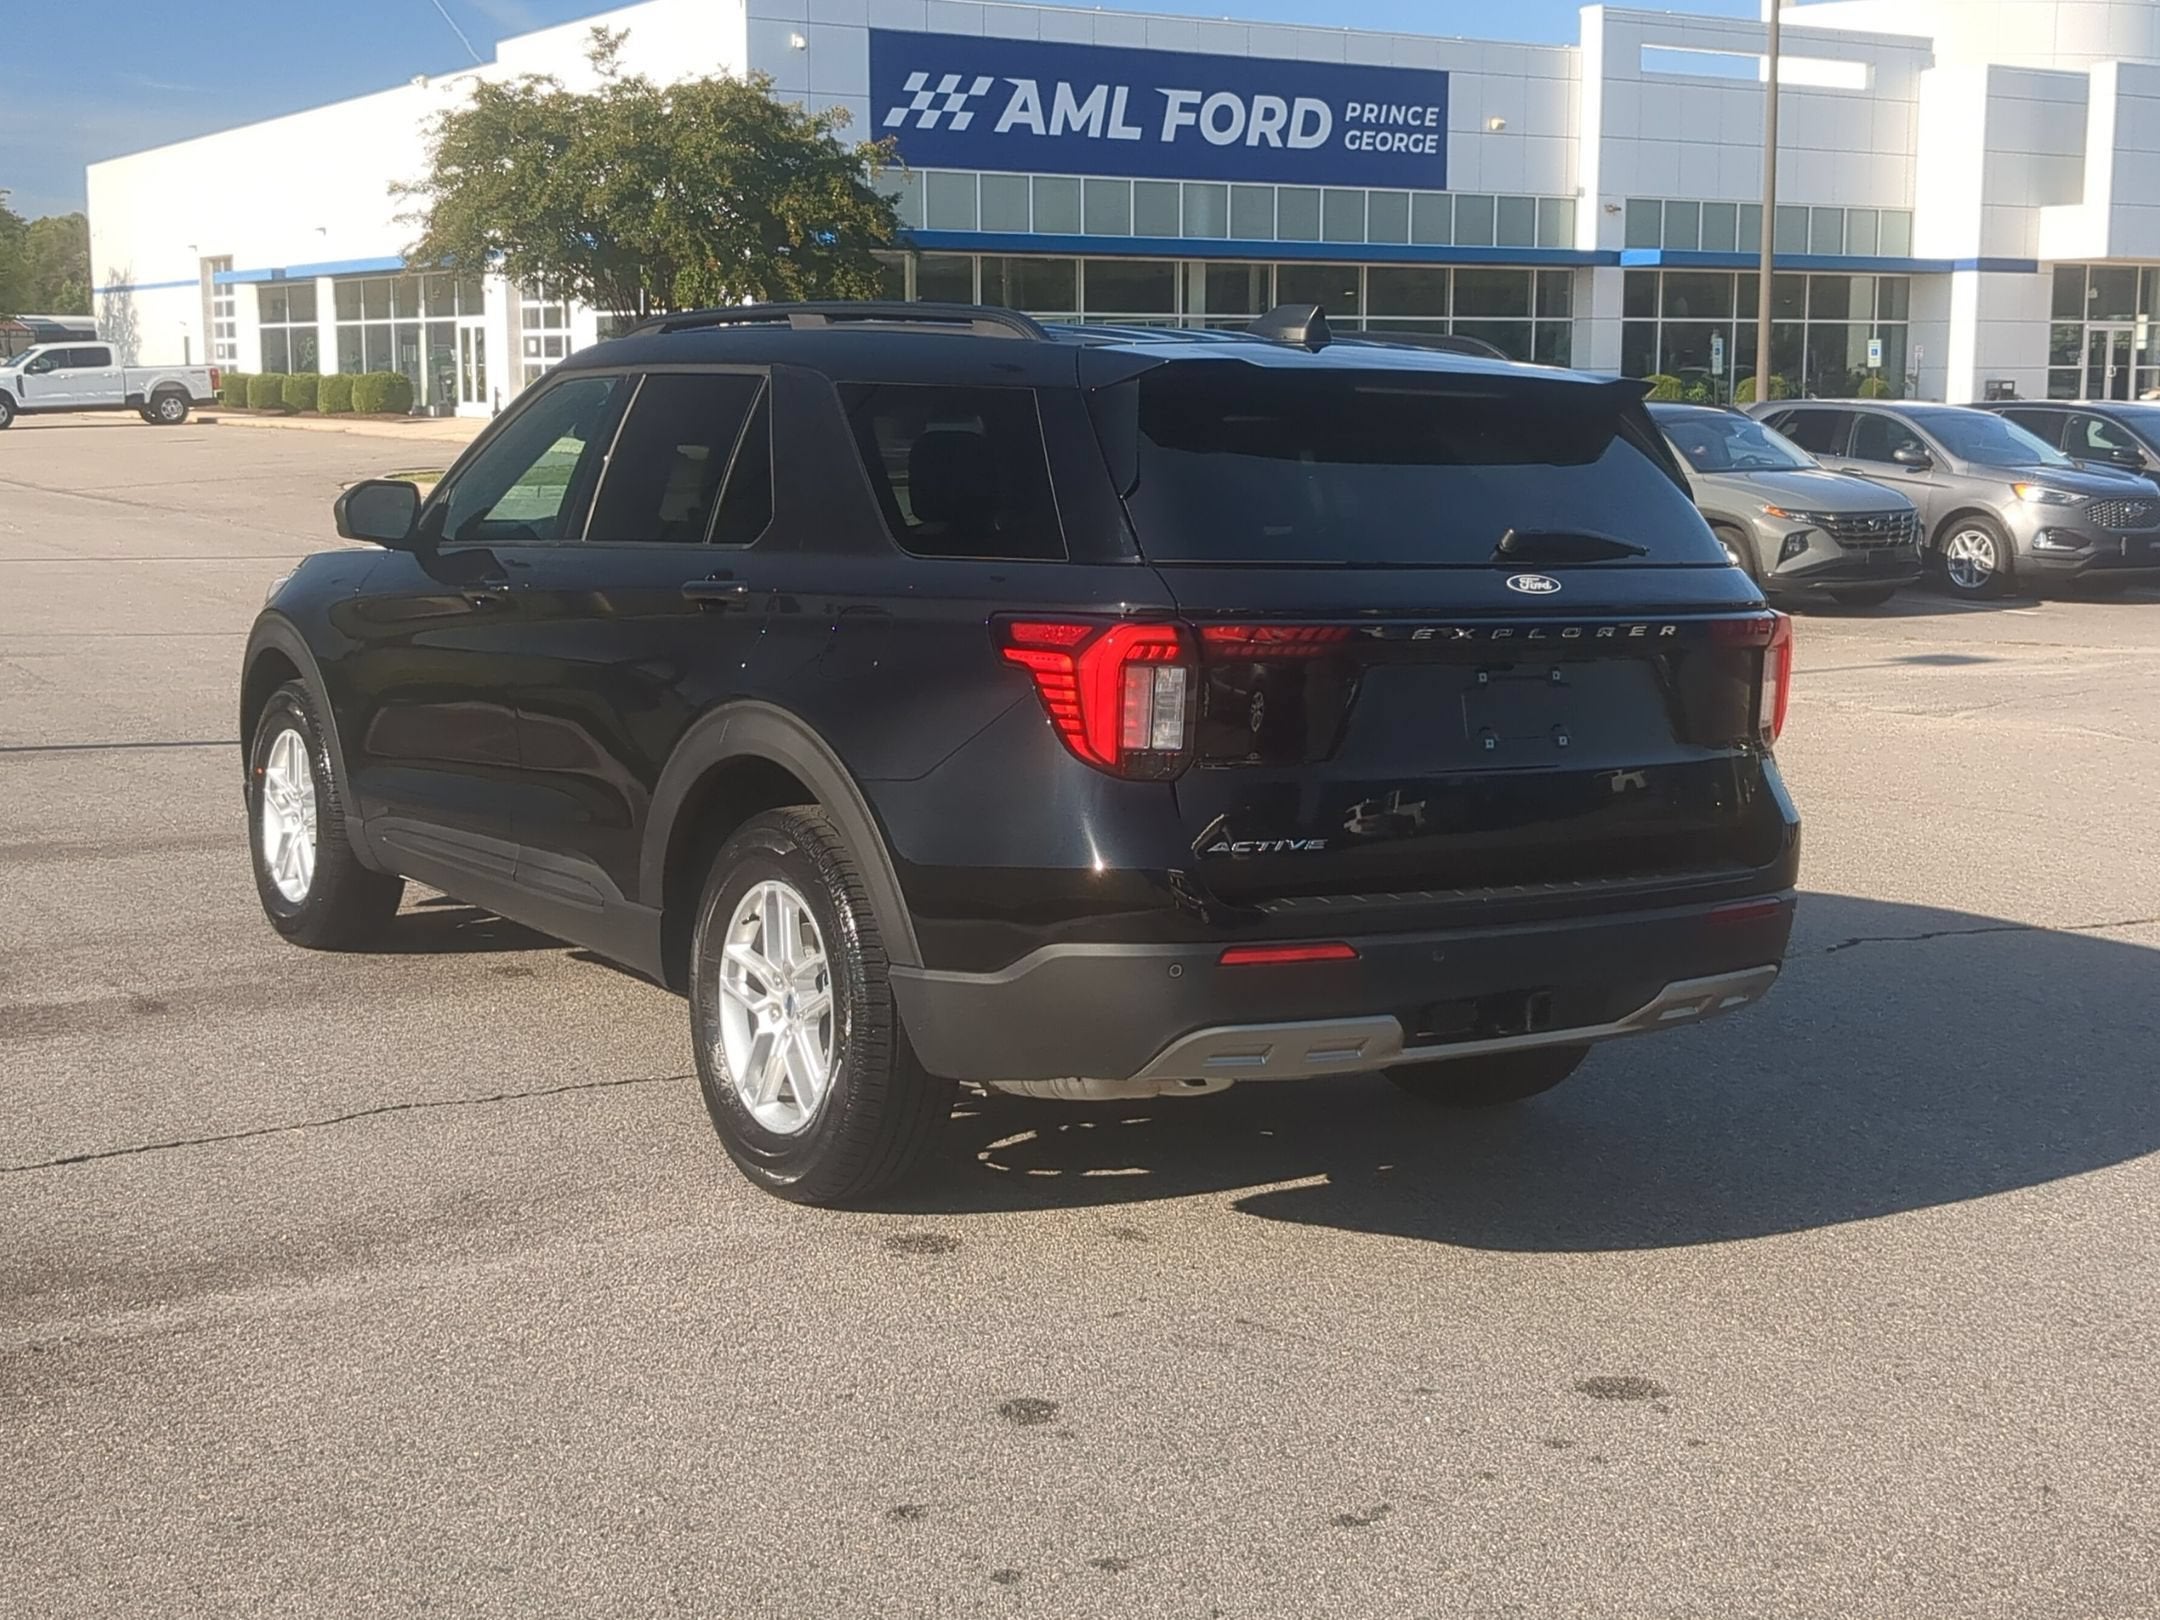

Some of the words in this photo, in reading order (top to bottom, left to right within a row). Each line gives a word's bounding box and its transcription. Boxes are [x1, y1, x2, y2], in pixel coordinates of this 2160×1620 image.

[994, 77, 1143, 140] AML
[1155, 87, 1334, 150] FORD
[1344, 101, 1440, 128] PRINCE
[1343, 129, 1438, 155] GEORGE
[1518, 577, 1553, 590] Ford
[1411, 624, 1677, 641] EXPLORER
[1207, 839, 1328, 852] ACTIVE
